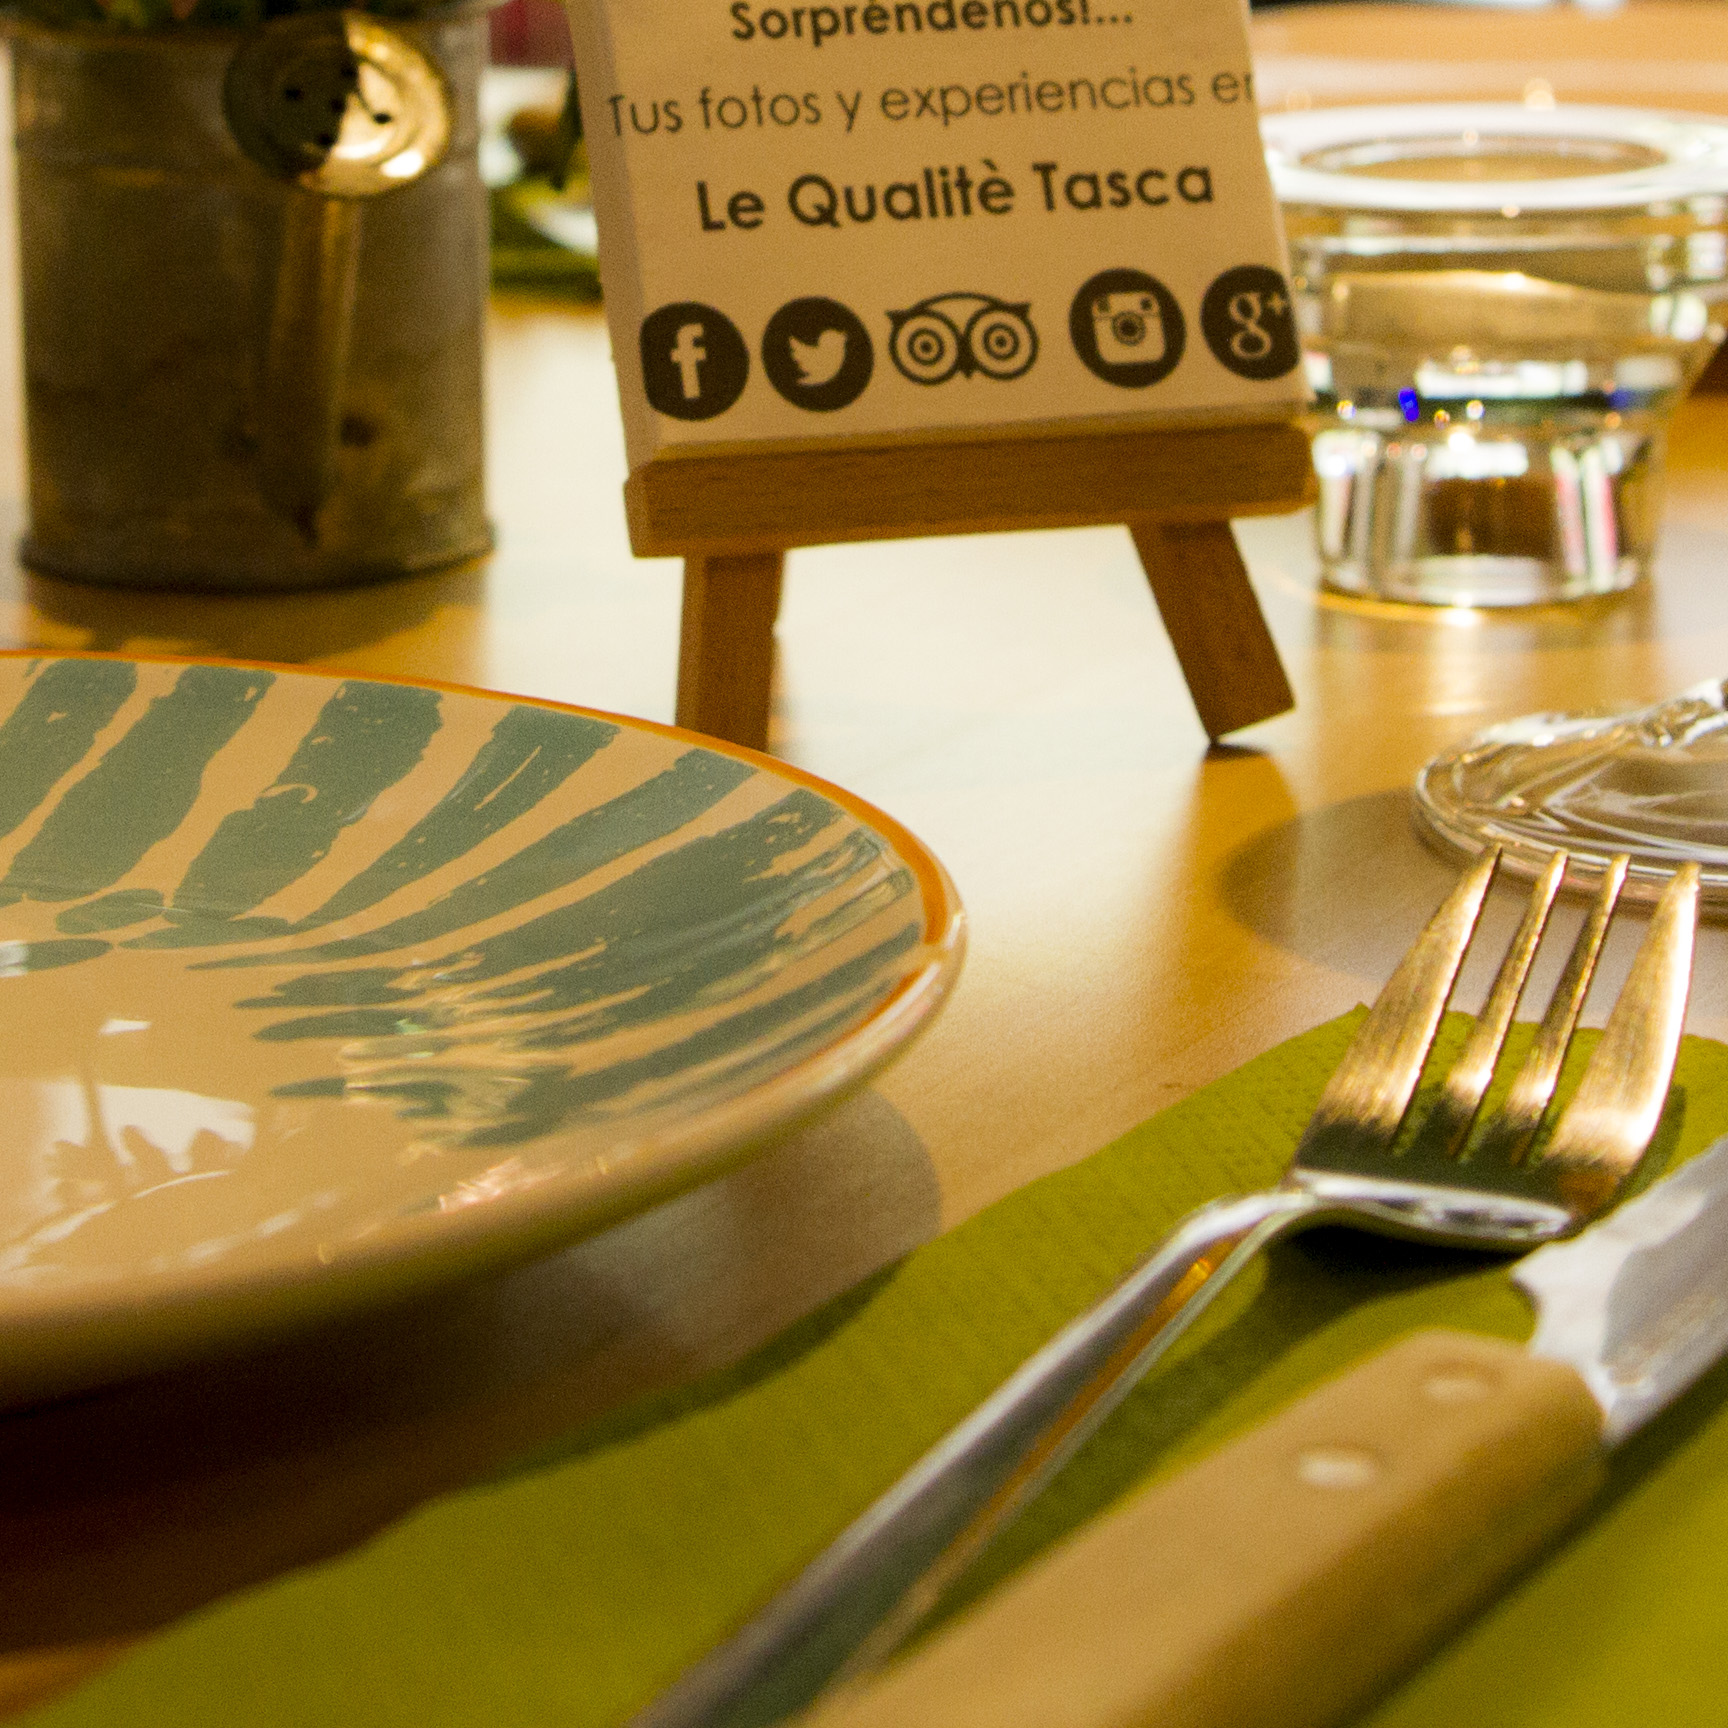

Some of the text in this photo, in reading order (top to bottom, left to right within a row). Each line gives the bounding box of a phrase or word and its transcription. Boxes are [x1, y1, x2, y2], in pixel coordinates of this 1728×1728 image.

[609, 93, 683, 137] Tus
[699, 84, 822, 130] fotos
[835, 92, 863, 132] y
[879, 67, 1196, 126] experiencias
[696, 159, 1214, 232] Le Qualitè Tasca
